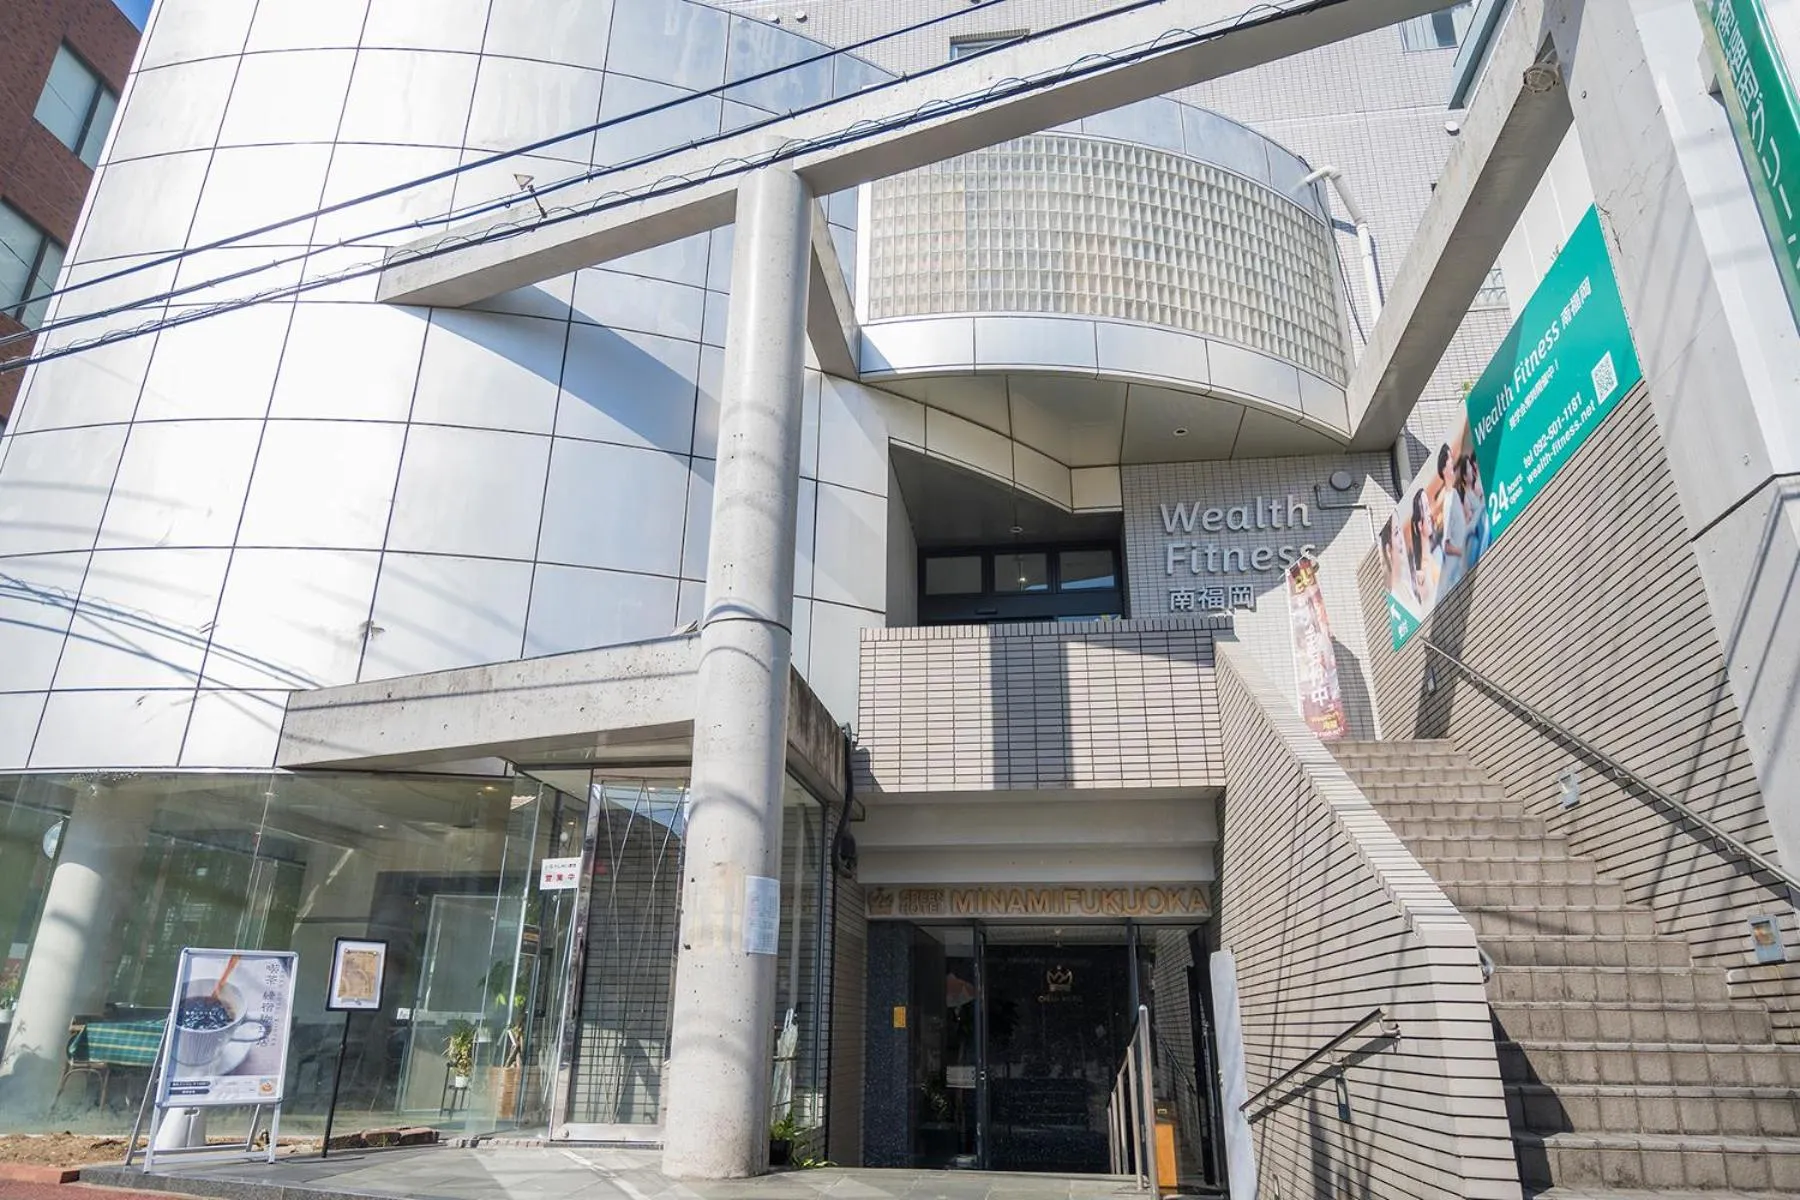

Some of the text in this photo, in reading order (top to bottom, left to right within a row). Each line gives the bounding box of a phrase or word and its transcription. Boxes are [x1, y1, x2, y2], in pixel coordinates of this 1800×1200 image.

[1710, 0, 1800, 270] 南福岡グリー
[1474, 275, 1592, 445] Wealth Fitness 南福岡
[1523, 391, 1582, 469] tel 092-501-1181
[1526, 399, 1596, 484] wealth-fitness.net
[1160, 495, 1311, 534] Wealth
[1488, 480, 1509, 526] 24
[1168, 583, 1256, 612] 南福岡
